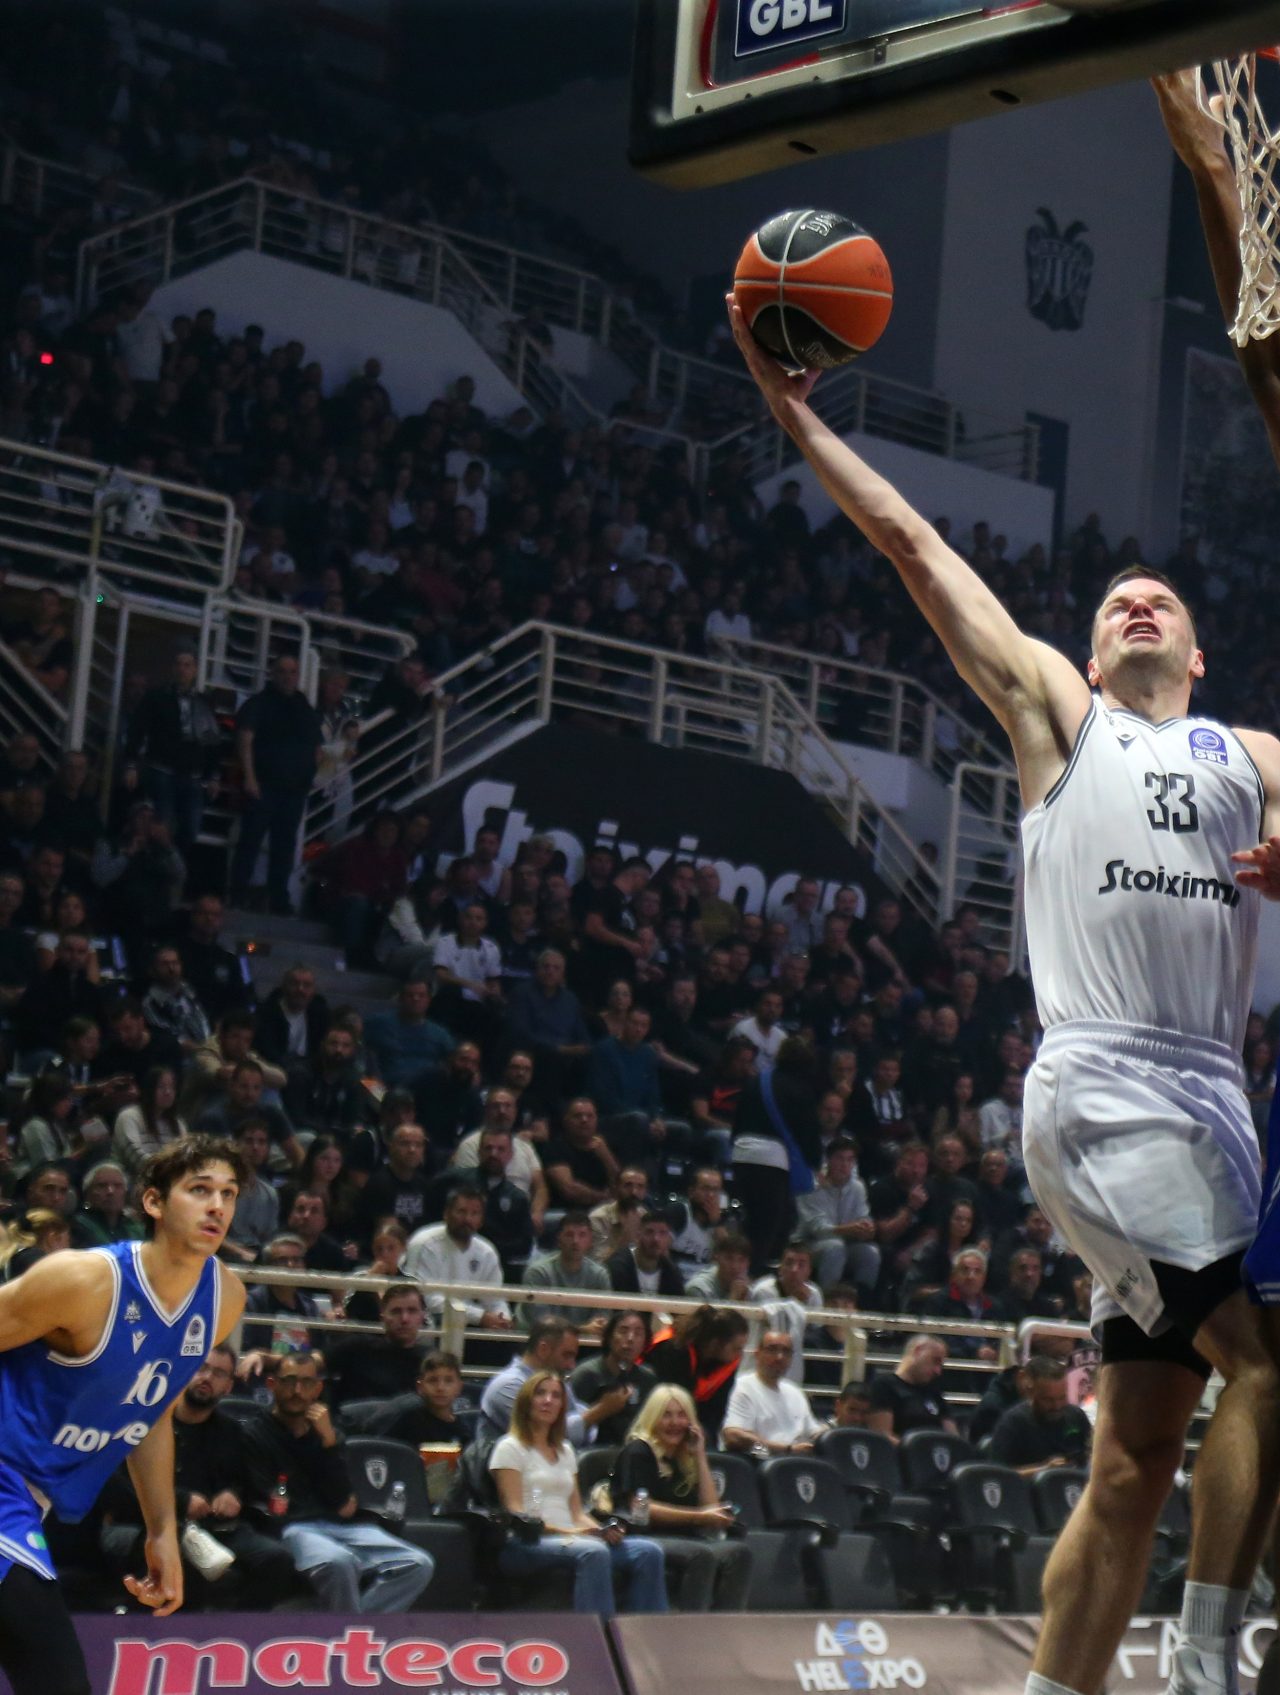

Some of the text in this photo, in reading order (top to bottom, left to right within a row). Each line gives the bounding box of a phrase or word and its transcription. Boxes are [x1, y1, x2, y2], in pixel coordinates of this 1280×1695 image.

[749, 0, 832, 36] GBL
[1144, 771, 1199, 833] 33
[1098, 859, 1240, 908] Stoixim
[120, 1359, 173, 1407] 16
[98, 1626, 569, 1695] mateco
[794, 1657, 927, 1692] HELEXPO
